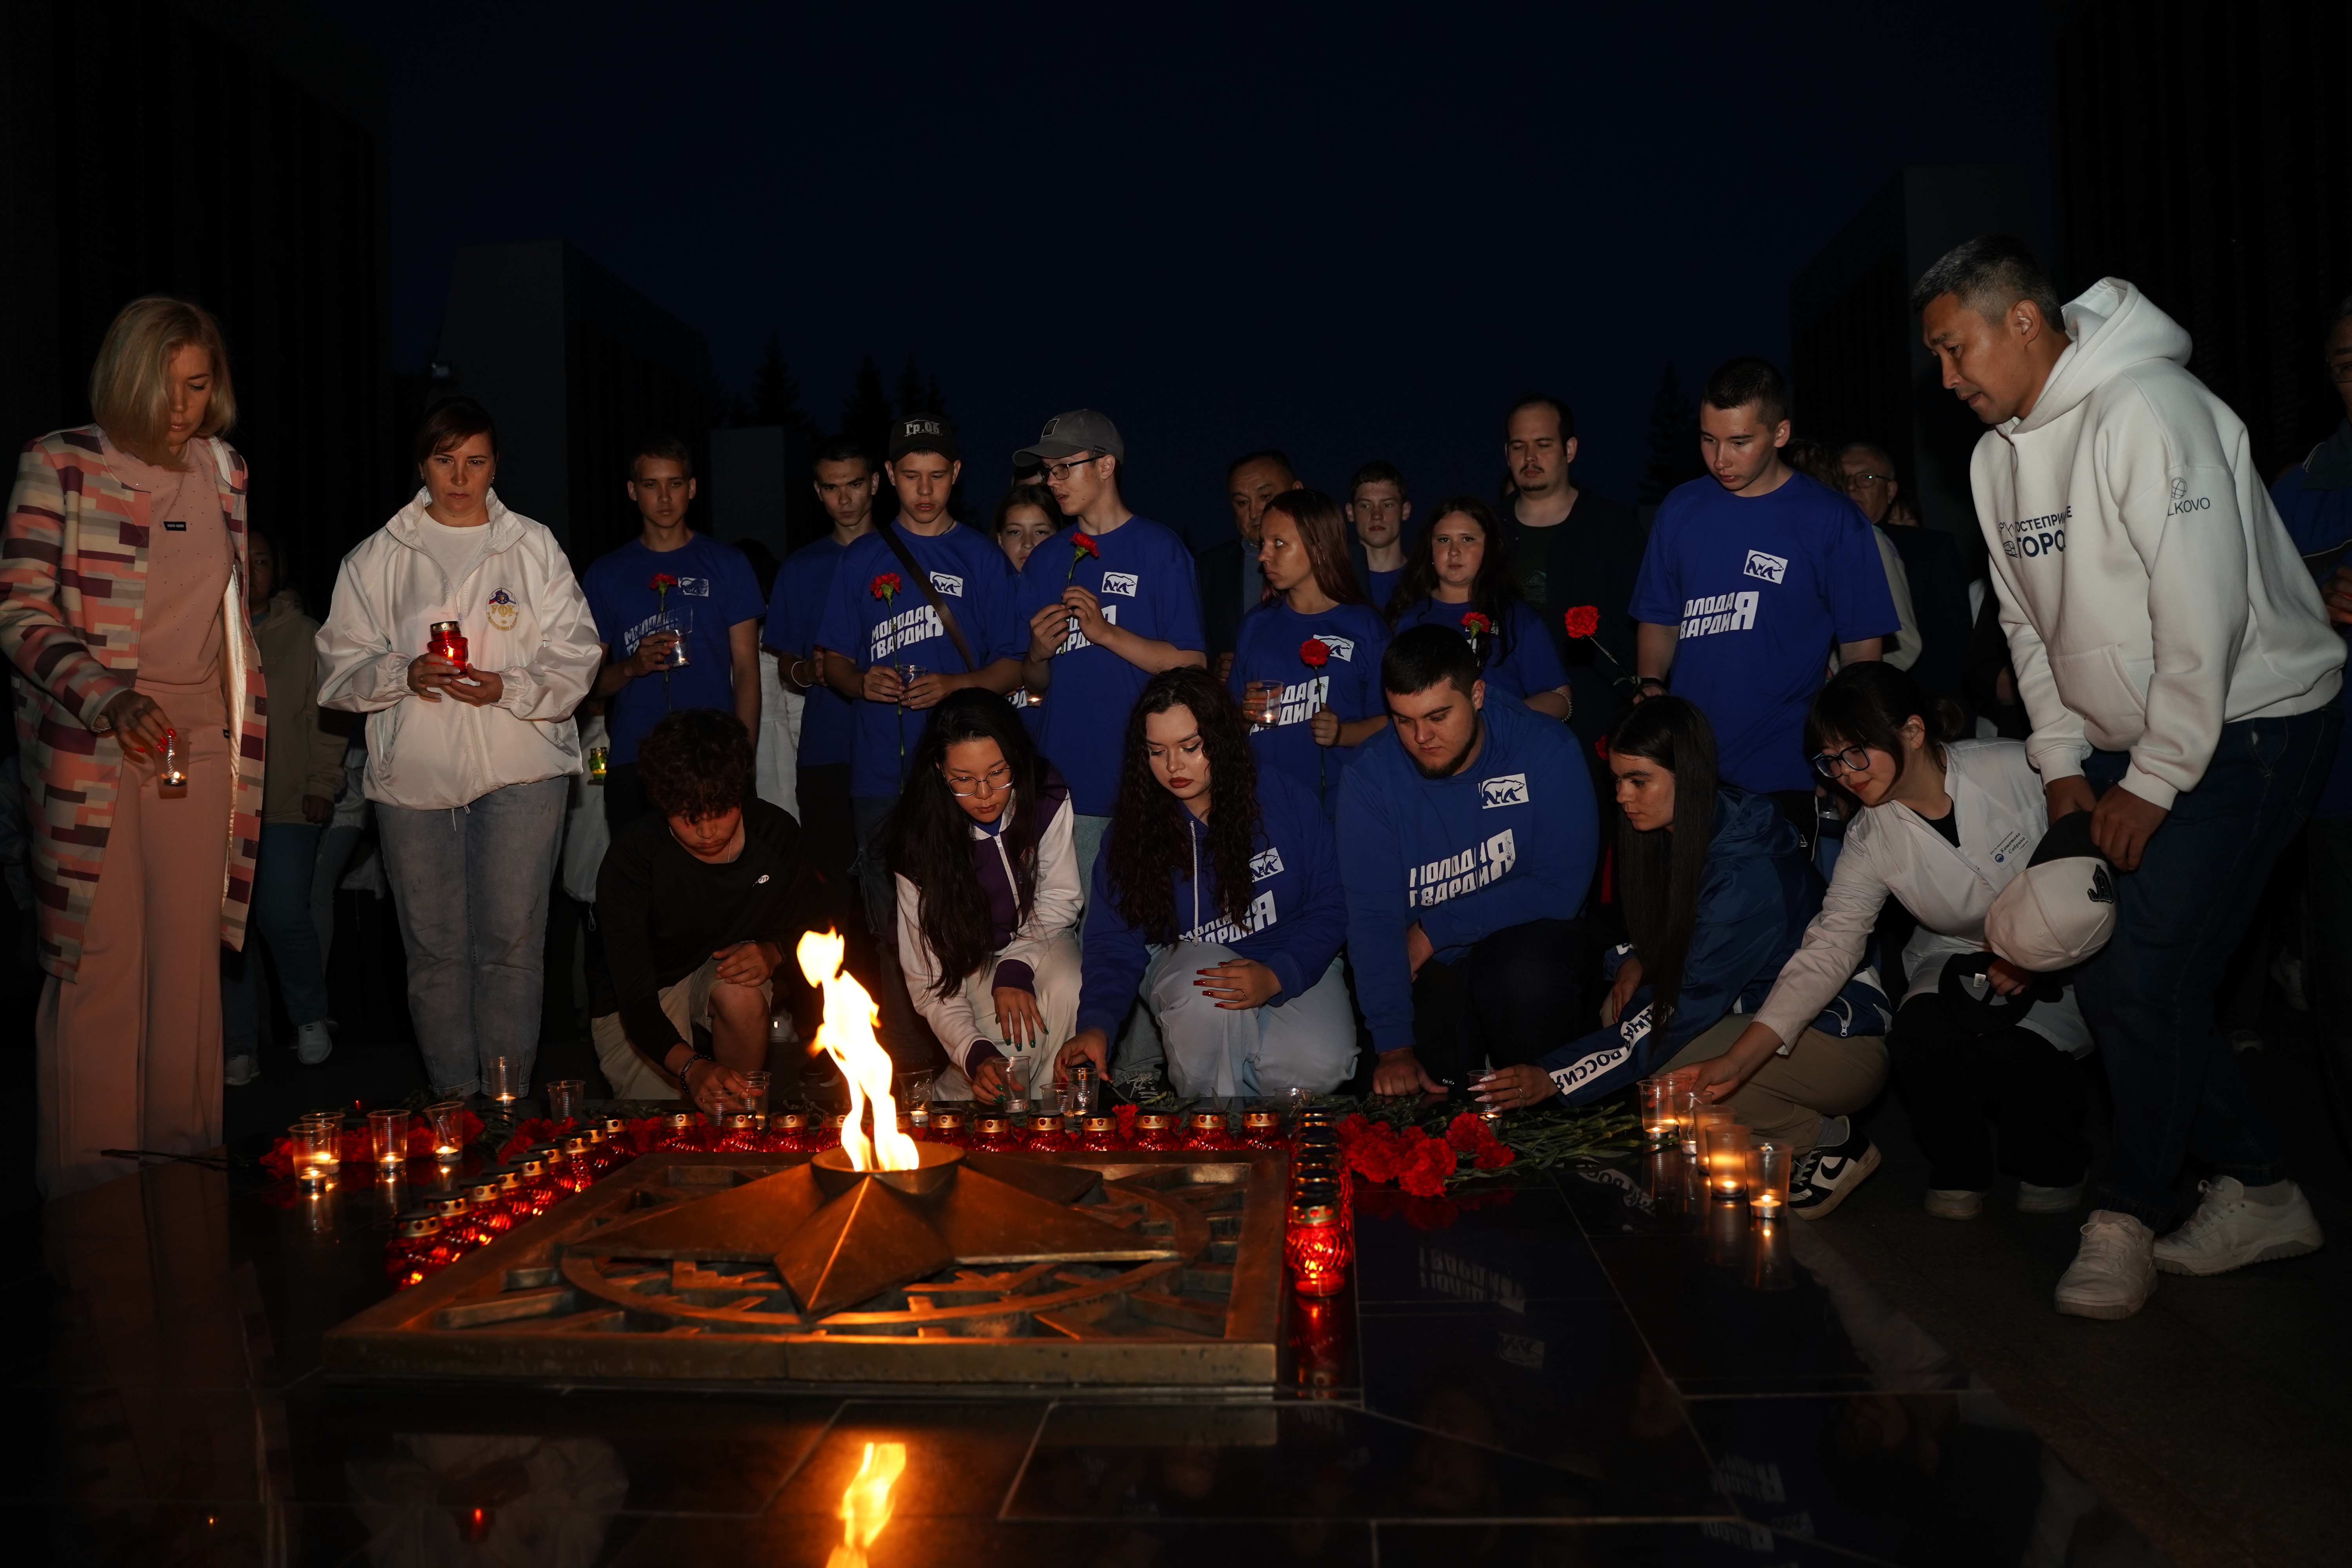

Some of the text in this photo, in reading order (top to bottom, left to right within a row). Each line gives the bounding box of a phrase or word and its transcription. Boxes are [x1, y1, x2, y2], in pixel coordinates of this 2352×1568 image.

[2167, 497, 2210, 516] LKOVO
[2016, 530, 2066, 558] ГОРО
[491, 604, 515, 617] УФК
[871, 605, 944, 644] МОЛОДАЯ
[1682, 591, 1759, 630] ОЛОДАЯ
[1677, 612, 1759, 641] ВАРДИЯ
[2008, 837, 2025, 853] Сабрина
[1552, 1050, 1622, 1091] РОССИЯ
